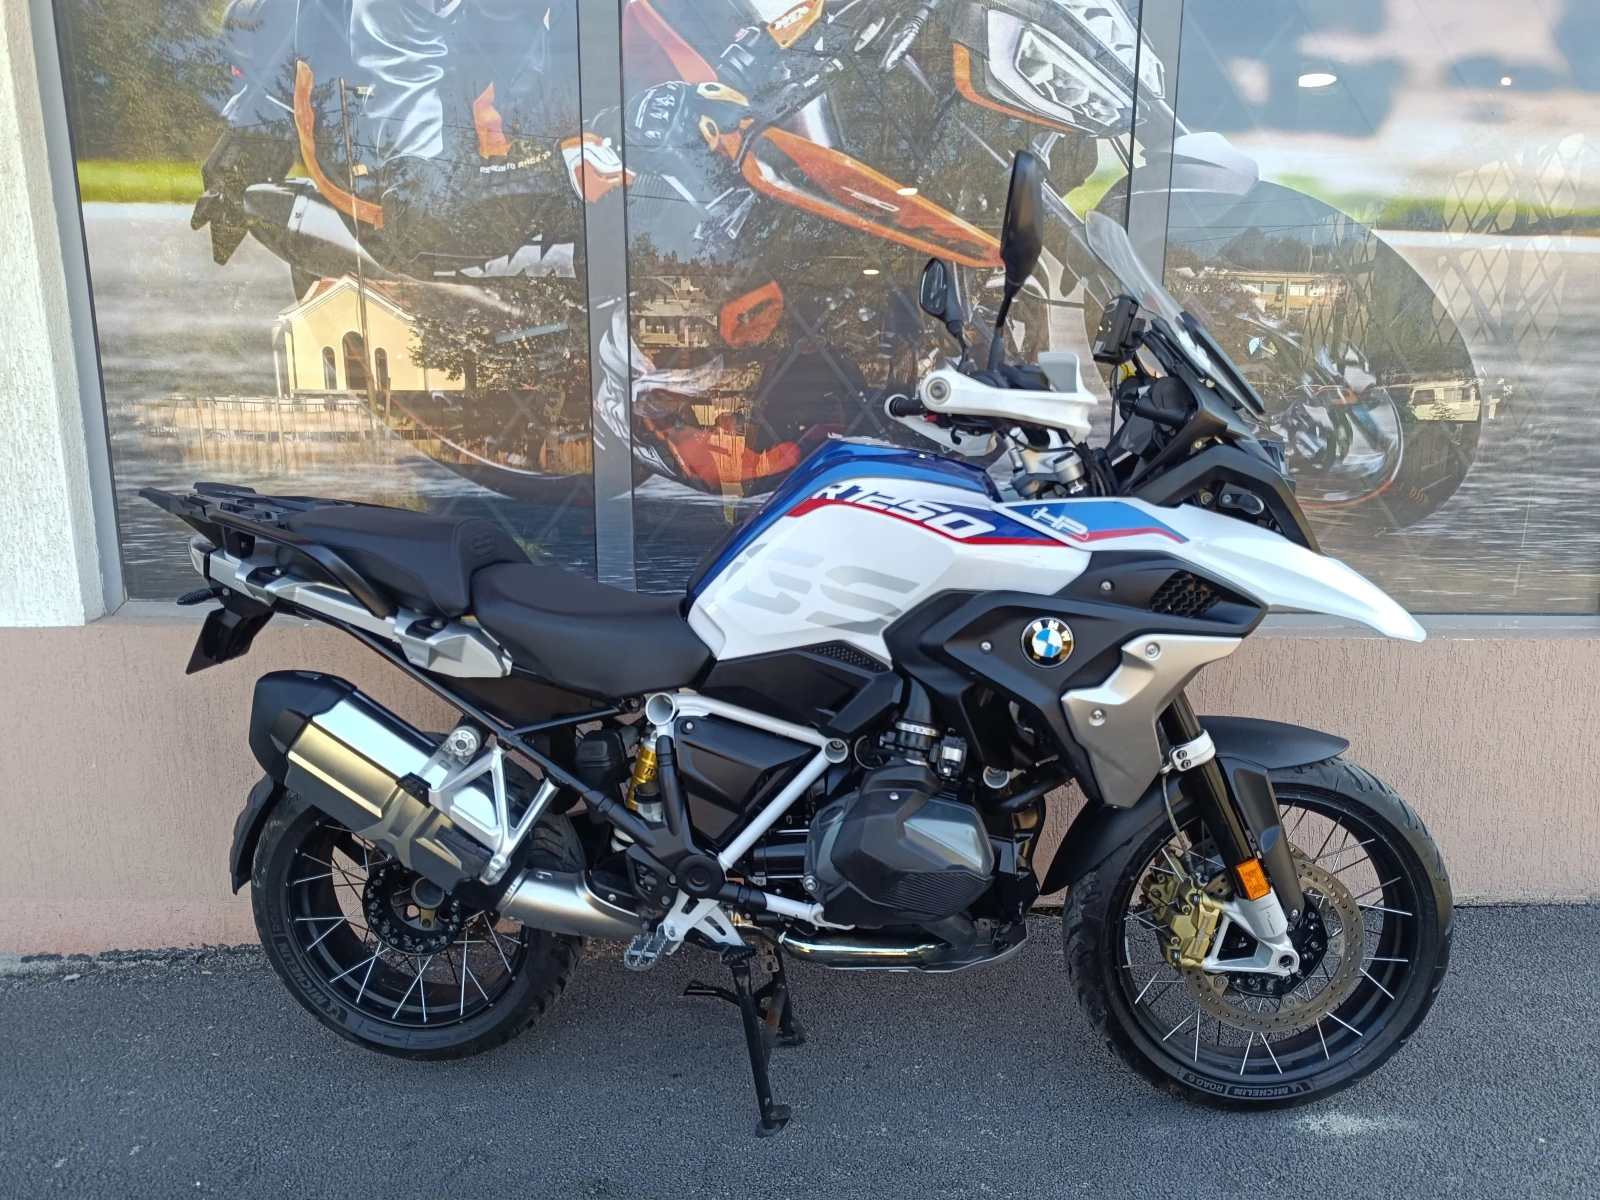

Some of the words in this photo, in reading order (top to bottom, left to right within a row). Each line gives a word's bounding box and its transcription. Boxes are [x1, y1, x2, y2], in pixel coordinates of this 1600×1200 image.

[1030, 506, 1090, 541] HP
[1032, 619, 1071, 641] BMW
[277, 941, 326, 1006] MICHELIN
[1196, 1079, 1224, 1092] ROAD
[1234, 1086, 1289, 1096] MICHELIN
